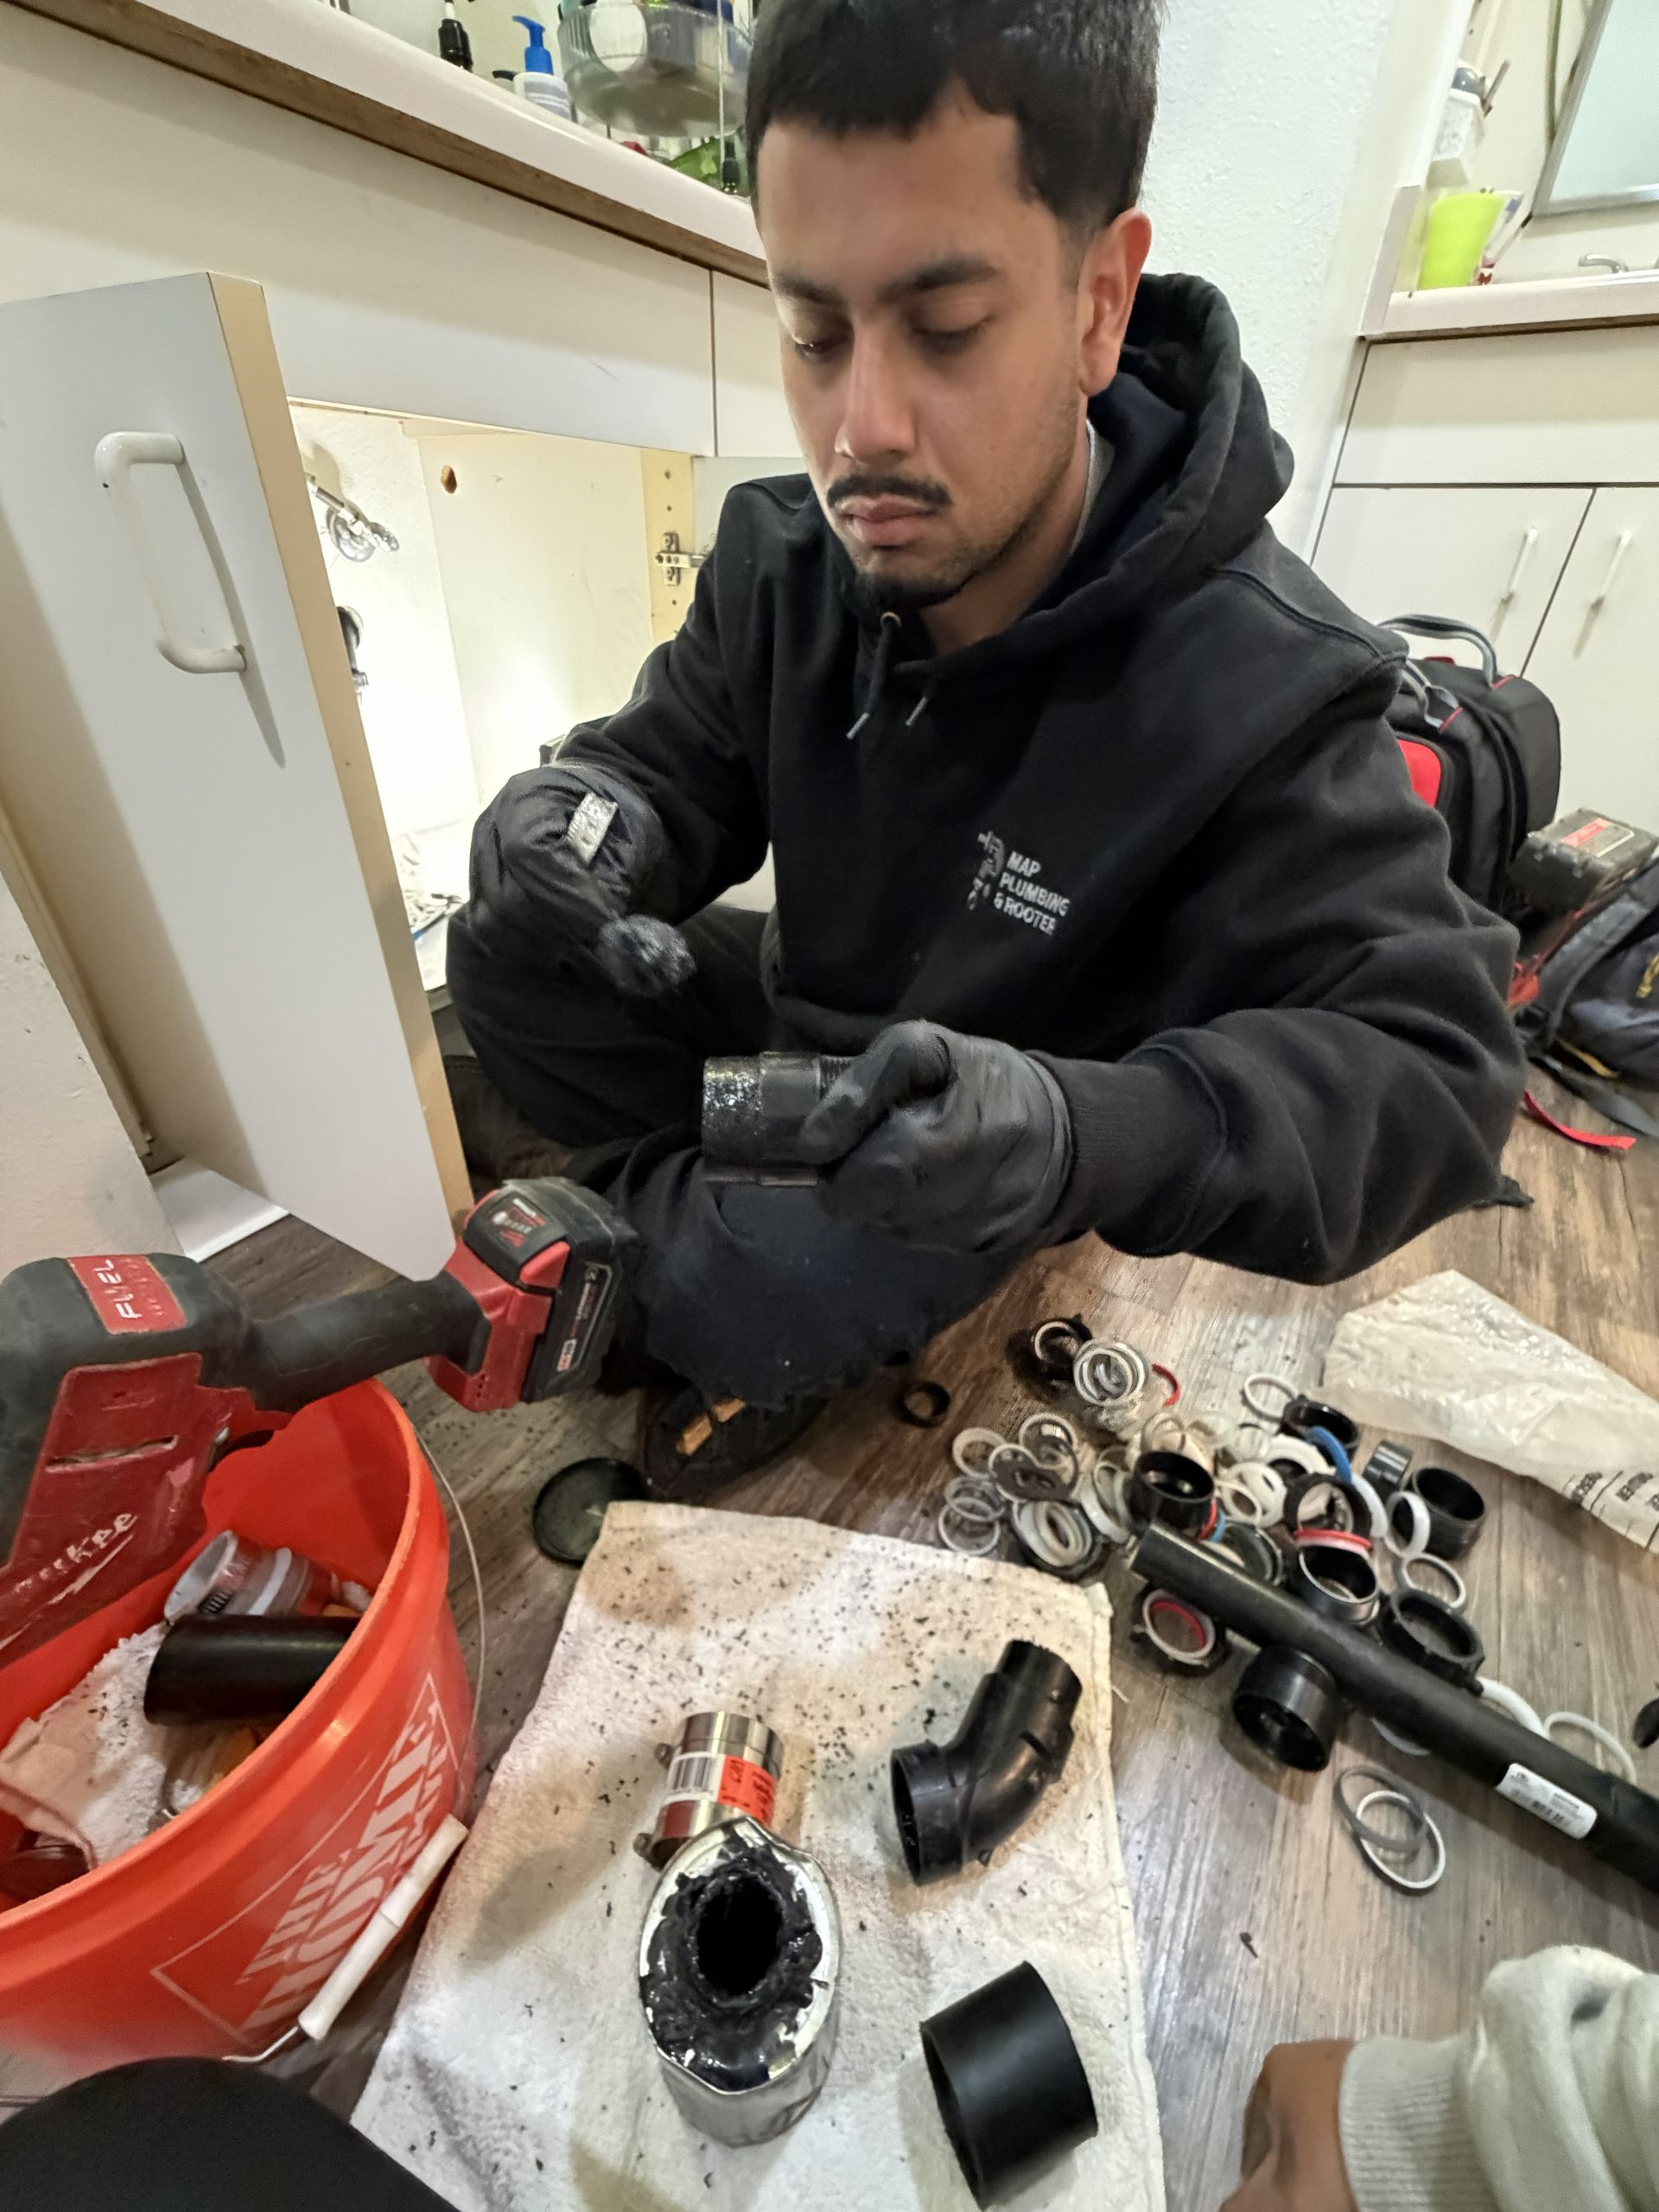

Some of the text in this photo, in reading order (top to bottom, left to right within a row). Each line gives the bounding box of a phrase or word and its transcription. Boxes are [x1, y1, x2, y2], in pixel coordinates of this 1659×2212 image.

[1007, 851, 1041, 878] MAP
[999, 871, 1071, 918] PLUMBING
[233, 1847, 351, 1986] THE
